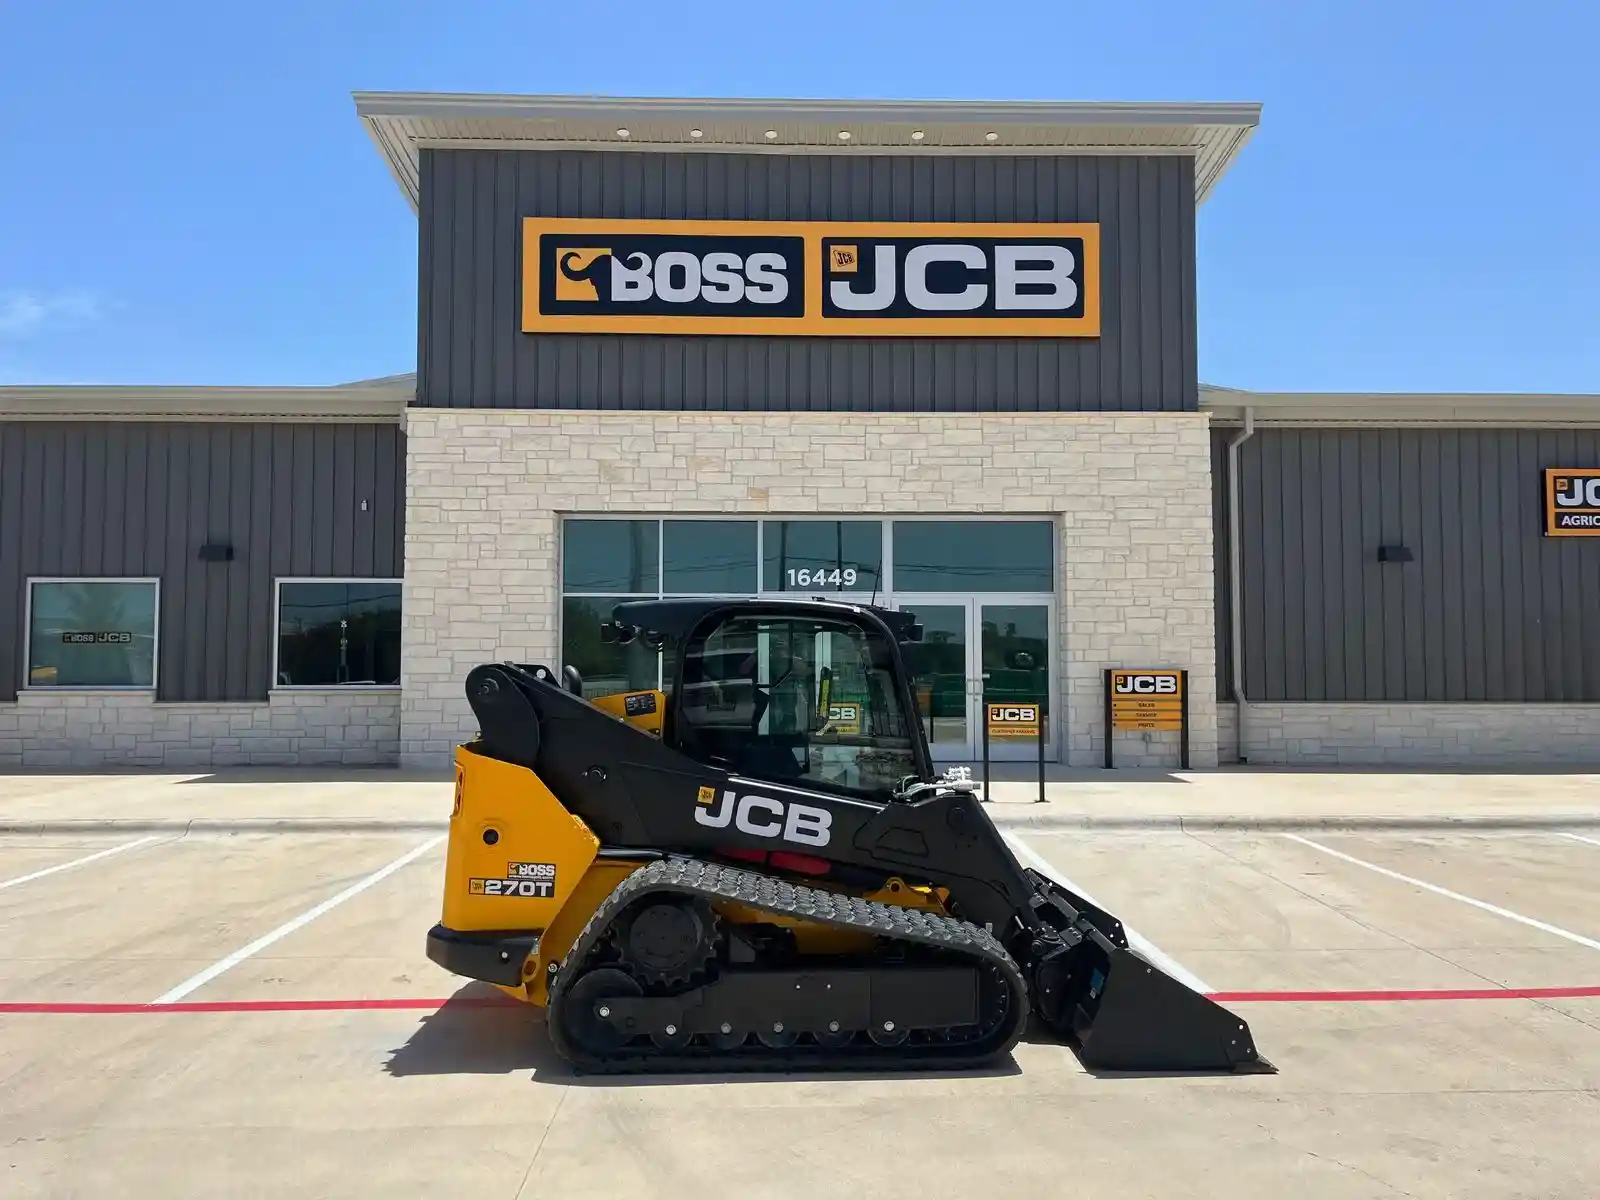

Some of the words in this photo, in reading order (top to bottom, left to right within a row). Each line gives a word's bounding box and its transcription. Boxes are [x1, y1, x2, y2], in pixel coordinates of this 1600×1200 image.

[611, 251, 789, 304] BOSS
[830, 244, 1078, 310] JCB
[787, 568, 857, 586] 16449
[98, 632, 131, 642] JCB
[1116, 676, 1177, 693] JCB
[829, 707, 856, 720] CB
[992, 708, 1035, 721] JCB
[694, 790, 832, 847] JCB
[518, 864, 555, 876] BOSS
[485, 879, 553, 897] 270T
